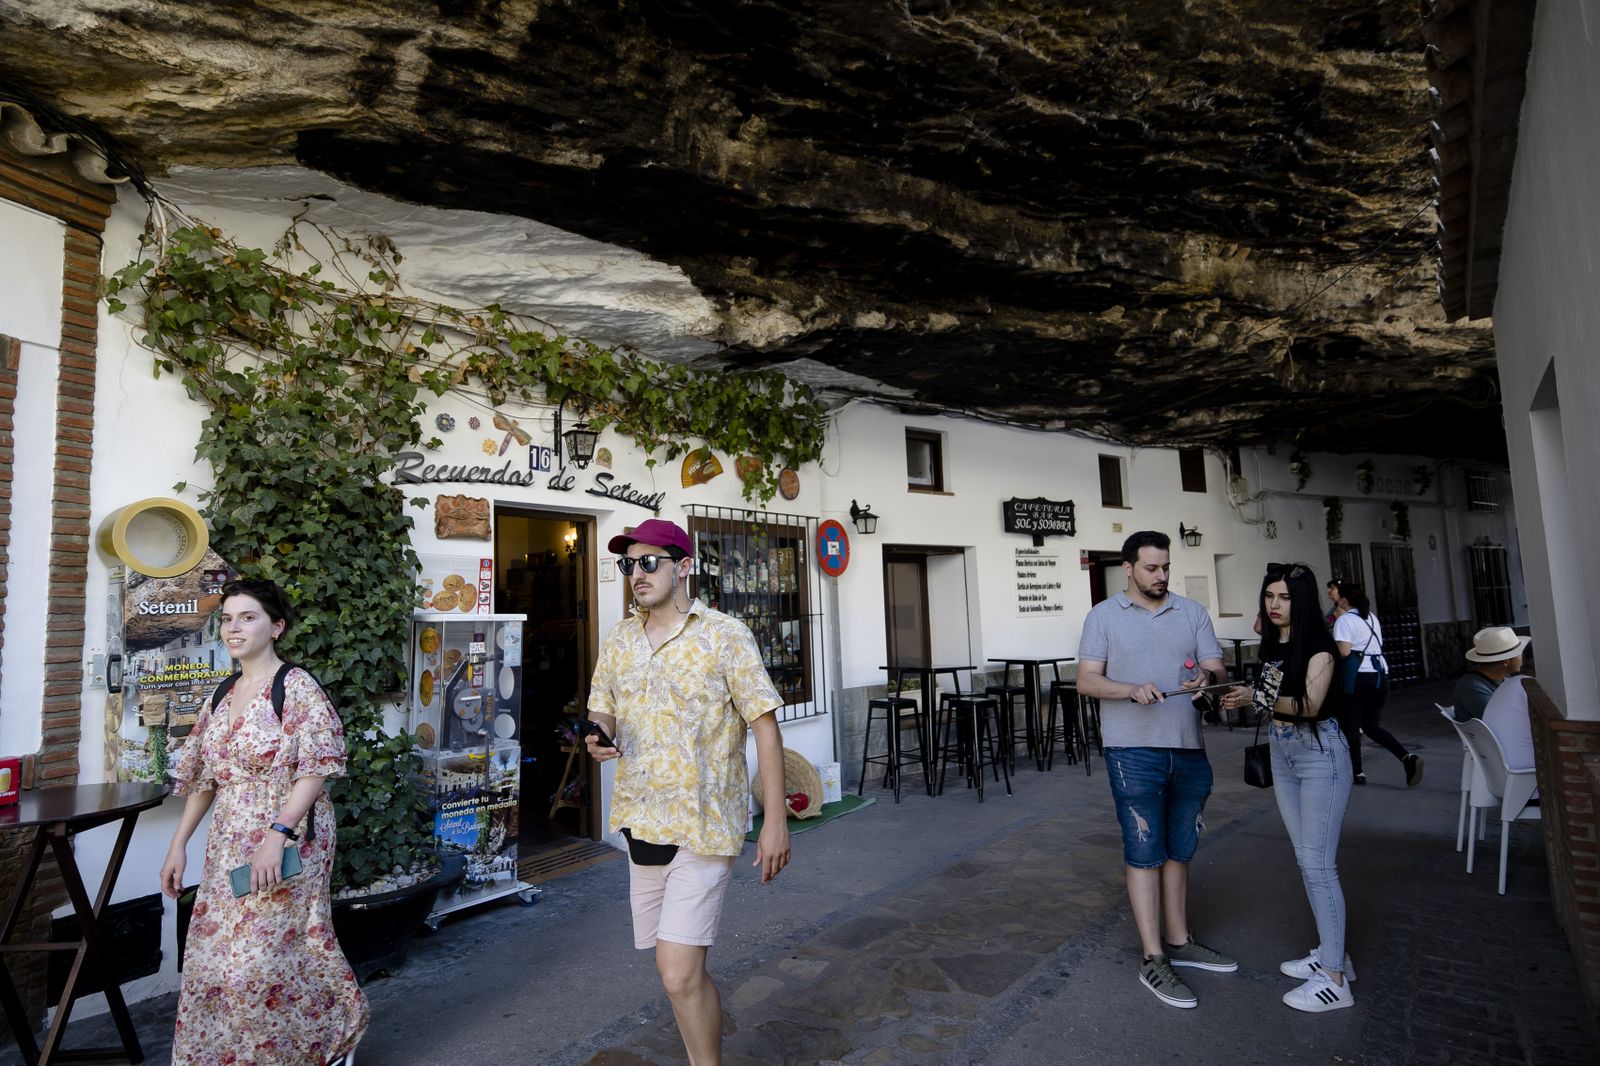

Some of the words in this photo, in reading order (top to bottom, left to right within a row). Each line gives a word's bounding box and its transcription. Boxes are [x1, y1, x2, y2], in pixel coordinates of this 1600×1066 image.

[530, 447, 550, 470] 16
[391, 452, 534, 486] Recuerdos
[547, 466, 575, 491] de
[585, 472, 666, 512] Setenil
[1014, 502, 1071, 514] CAFETERIA
[1032, 511, 1054, 520] BAR
[1014, 518, 1031, 529] SOL
[1032, 520, 1038, 531] y
[1038, 518, 1072, 532] SOMBRA
[139, 599, 199, 615] Setenil
[164, 662, 210, 672] MONEDA
[140, 670, 233, 684] CONMEMORATIVA
[157, 682, 173, 690] your
[175, 679, 190, 687] coin
[191, 678, 205, 686] into
[481, 795, 489, 803] tu
[441, 807, 474, 819] moneda
[486, 799, 517, 812] medalla
